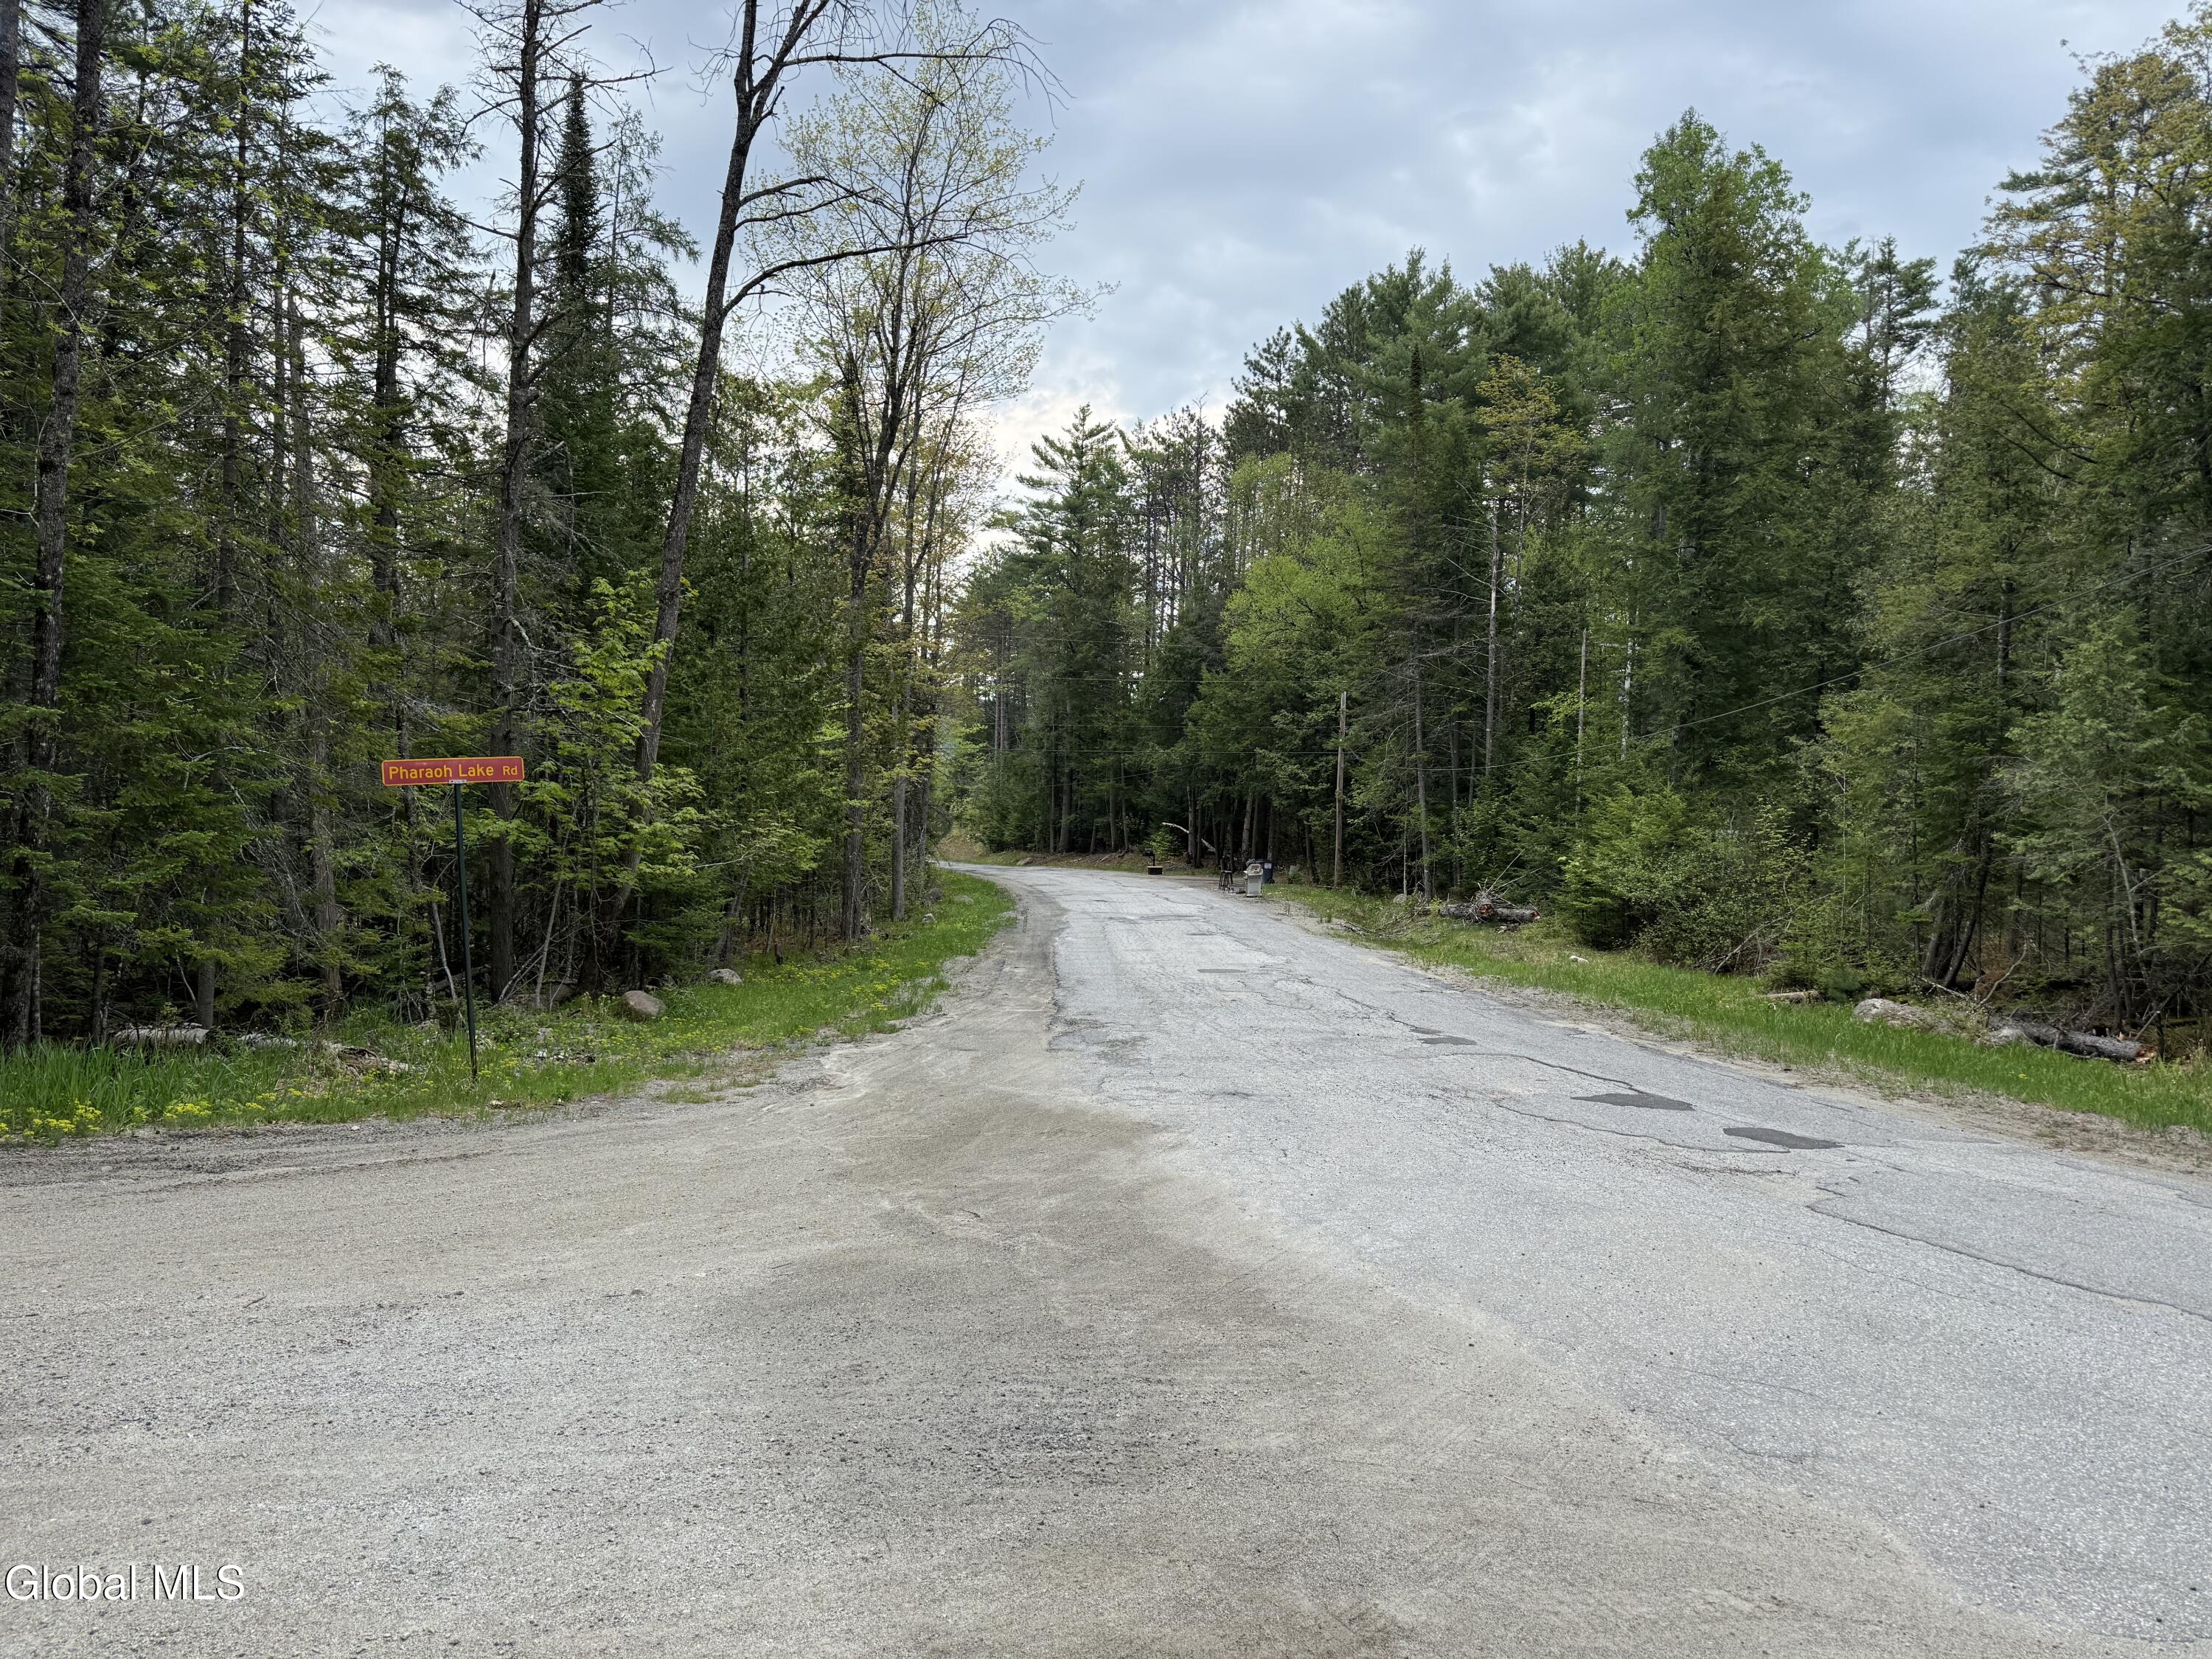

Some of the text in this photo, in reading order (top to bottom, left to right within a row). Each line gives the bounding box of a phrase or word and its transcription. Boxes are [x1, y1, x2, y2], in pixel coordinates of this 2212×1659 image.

[389, 764, 518, 779] Pharaoh Lake Rd
